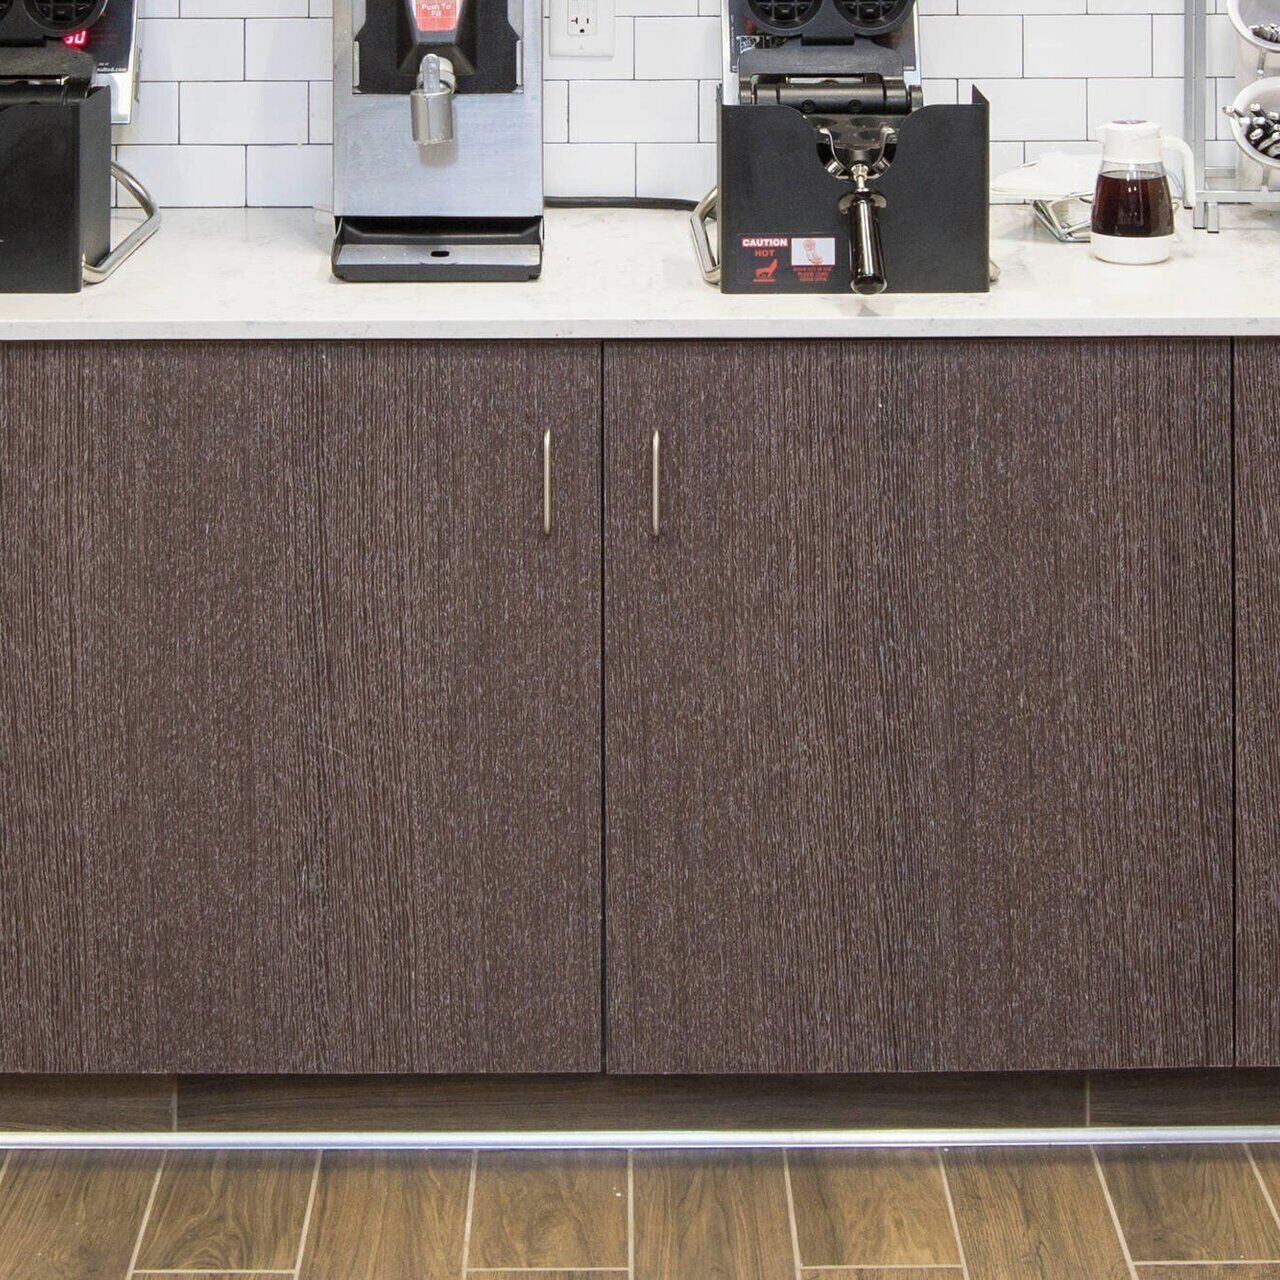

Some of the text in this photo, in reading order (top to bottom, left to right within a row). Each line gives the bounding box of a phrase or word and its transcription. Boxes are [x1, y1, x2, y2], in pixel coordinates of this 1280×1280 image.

[421, 3, 440, 11] Push
[742, 238, 788, 247] CAUTION
[754, 249, 775, 257] HOT
